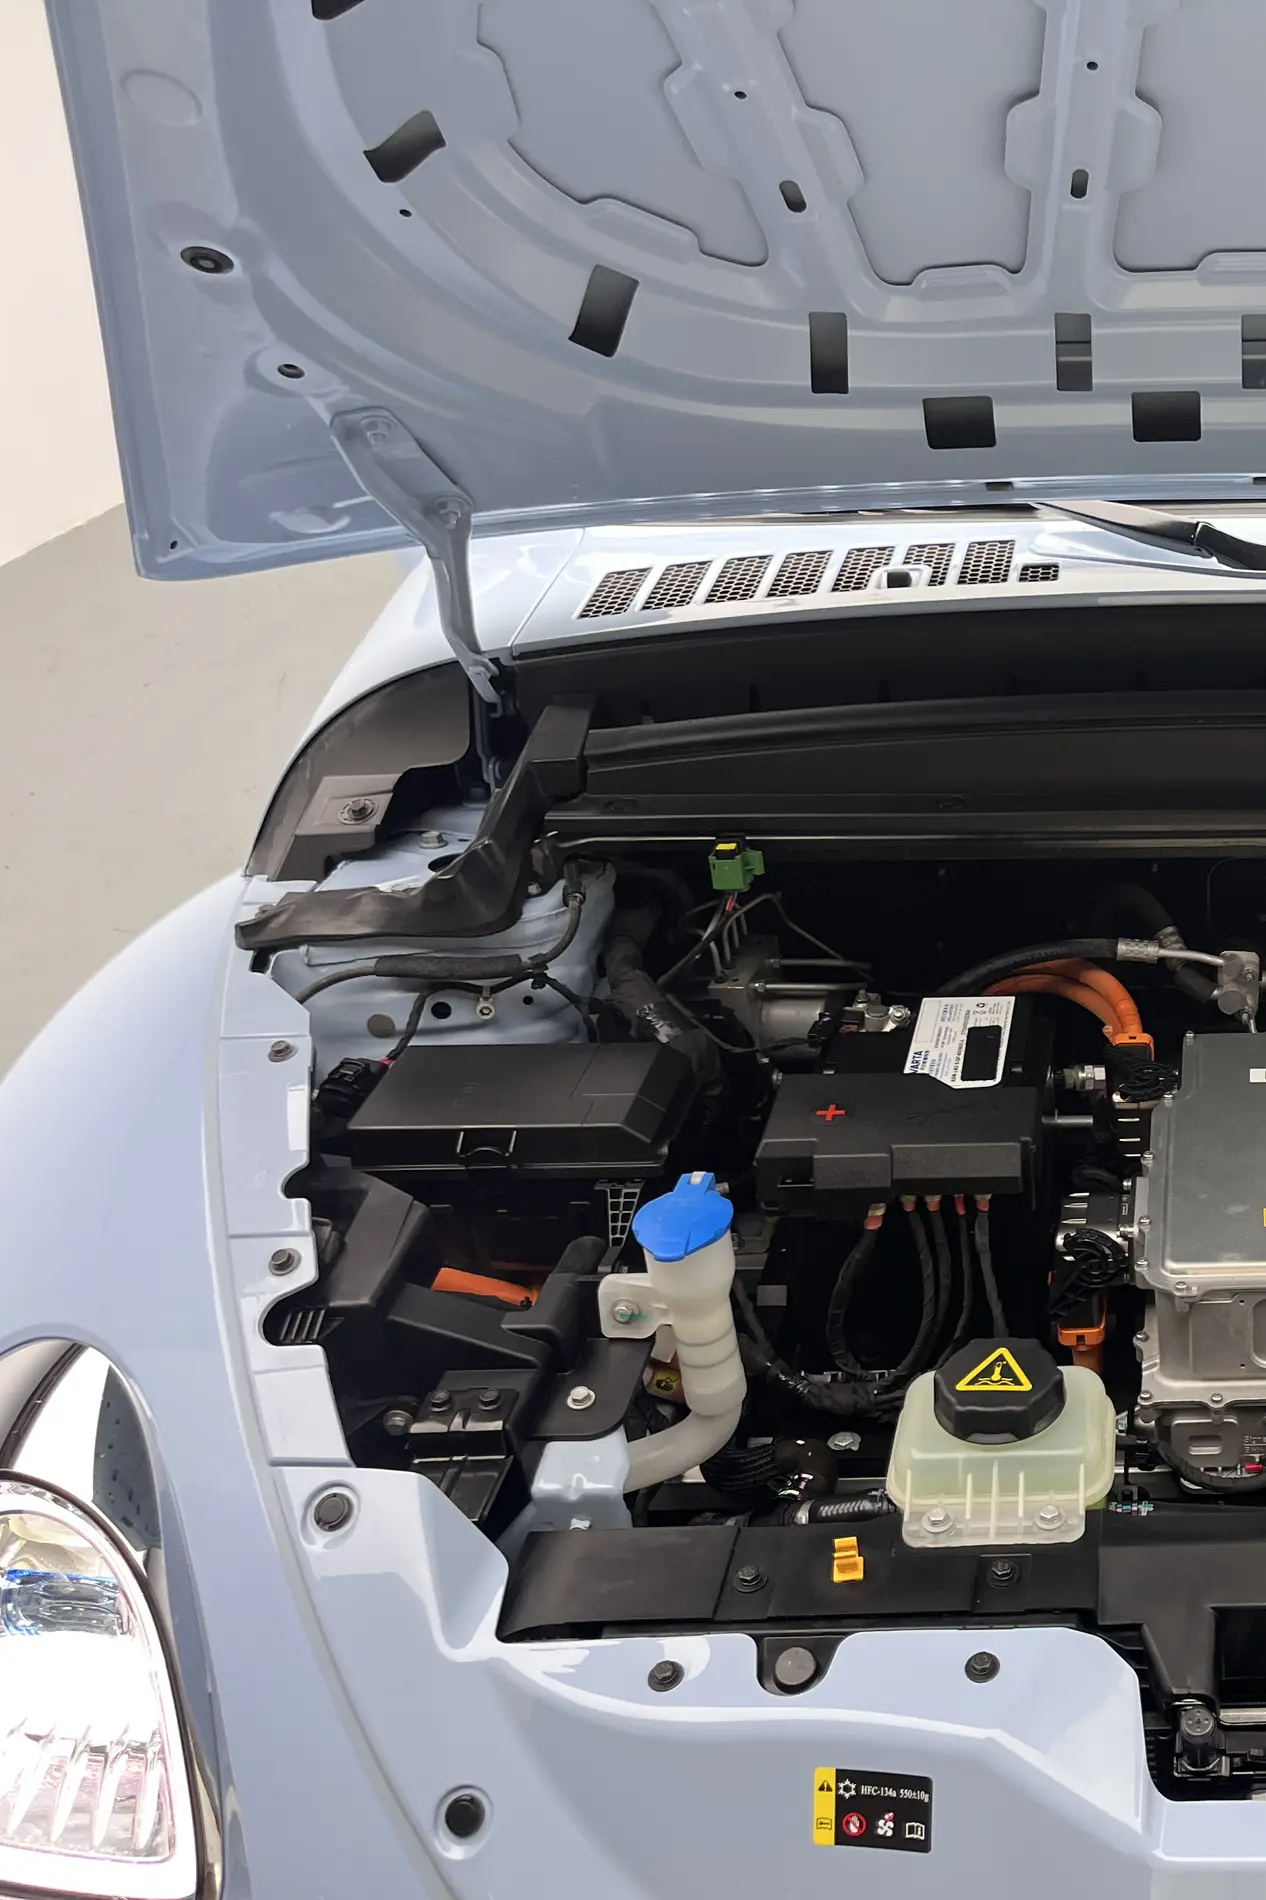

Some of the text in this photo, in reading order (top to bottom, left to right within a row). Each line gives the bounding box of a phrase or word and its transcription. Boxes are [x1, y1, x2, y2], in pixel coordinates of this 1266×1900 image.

[910, 1050, 924, 1073] VARTA
[861, 1785, 929, 1802] HFC-134a 550±10g
